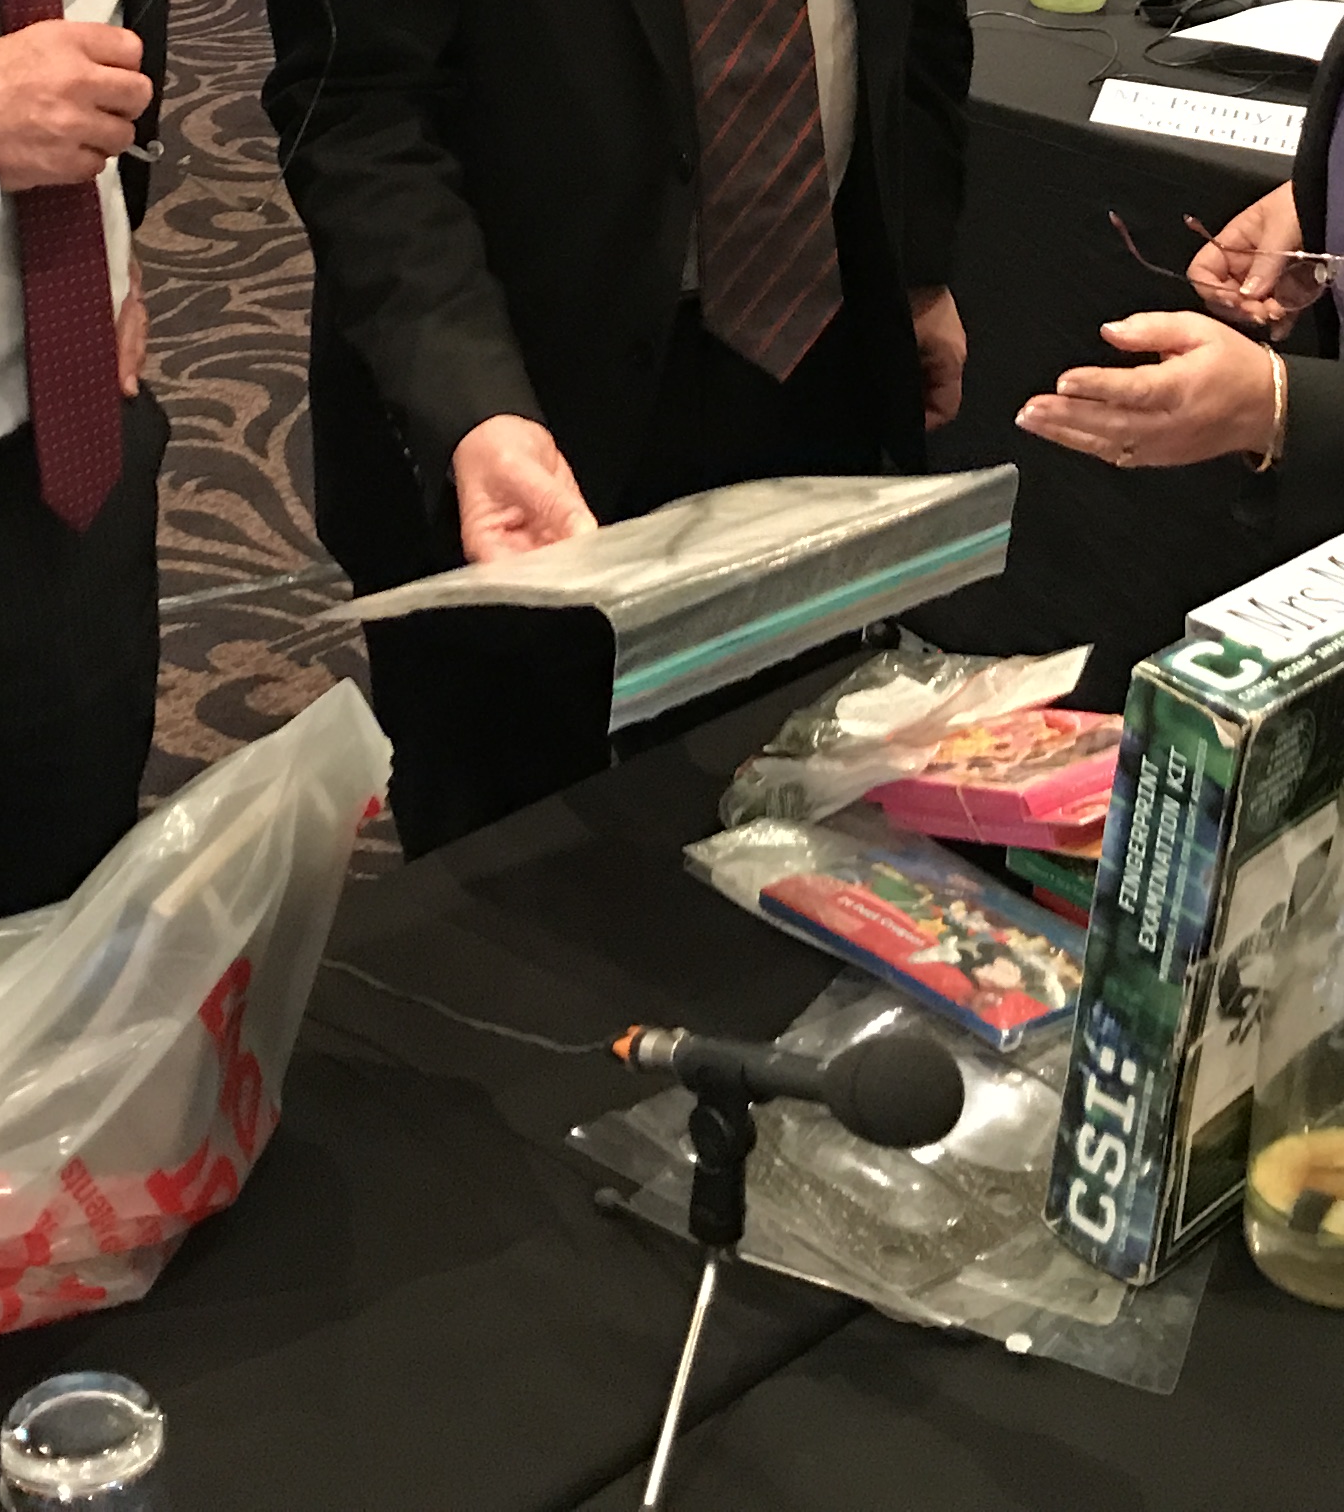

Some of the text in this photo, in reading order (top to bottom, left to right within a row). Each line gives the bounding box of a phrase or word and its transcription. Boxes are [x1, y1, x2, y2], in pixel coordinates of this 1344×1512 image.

[1119, 753, 1159, 915] FINGERPRINT
[1138, 793, 1181, 953] EXAMINATION
[1166, 744, 1188, 792] KIT
[1069, 1046, 1137, 1244] CSI:
